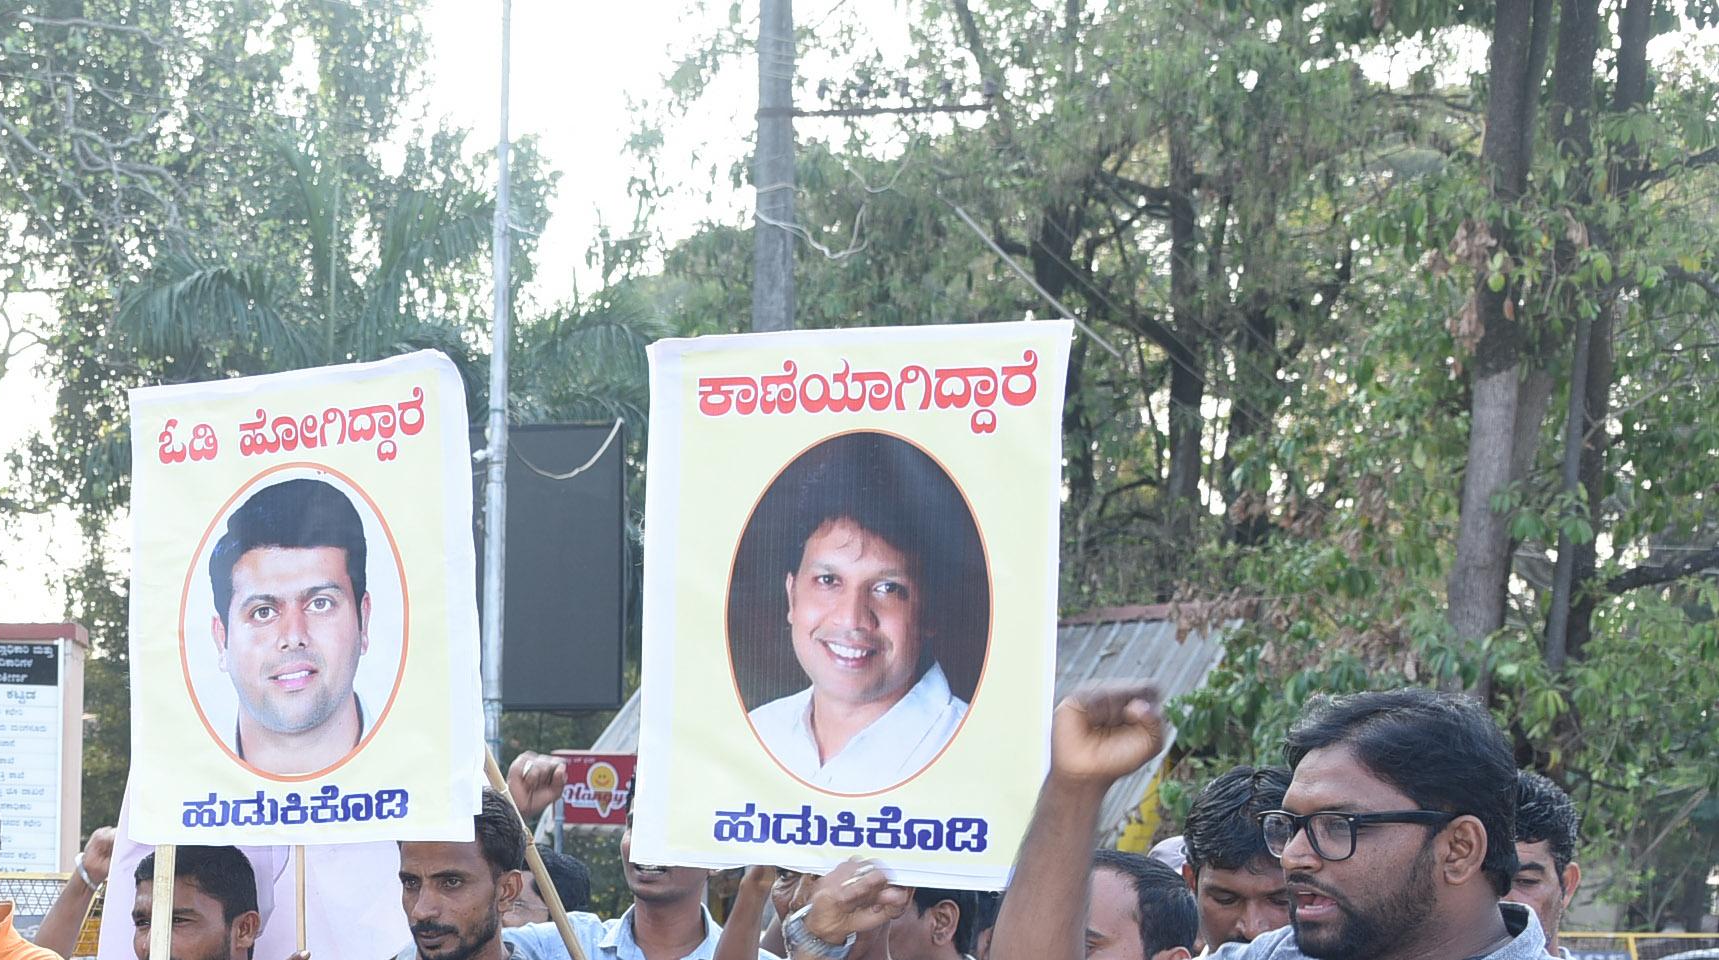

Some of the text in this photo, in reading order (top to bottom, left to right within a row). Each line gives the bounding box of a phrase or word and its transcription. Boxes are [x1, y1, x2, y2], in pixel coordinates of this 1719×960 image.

[698, 349, 1039, 434] ಕಾಣೆಯಾಗಿದ್ದಾರೆ
[158, 386, 426, 464] ಓಡಿ ಹೋಗಿದ್ದಾರೆ
[182, 784, 410, 828] ಹುಡುಕಿಕೊಡಿ
[713, 802, 989, 854] ಹುಡುಕಿಕೊಡಿ
